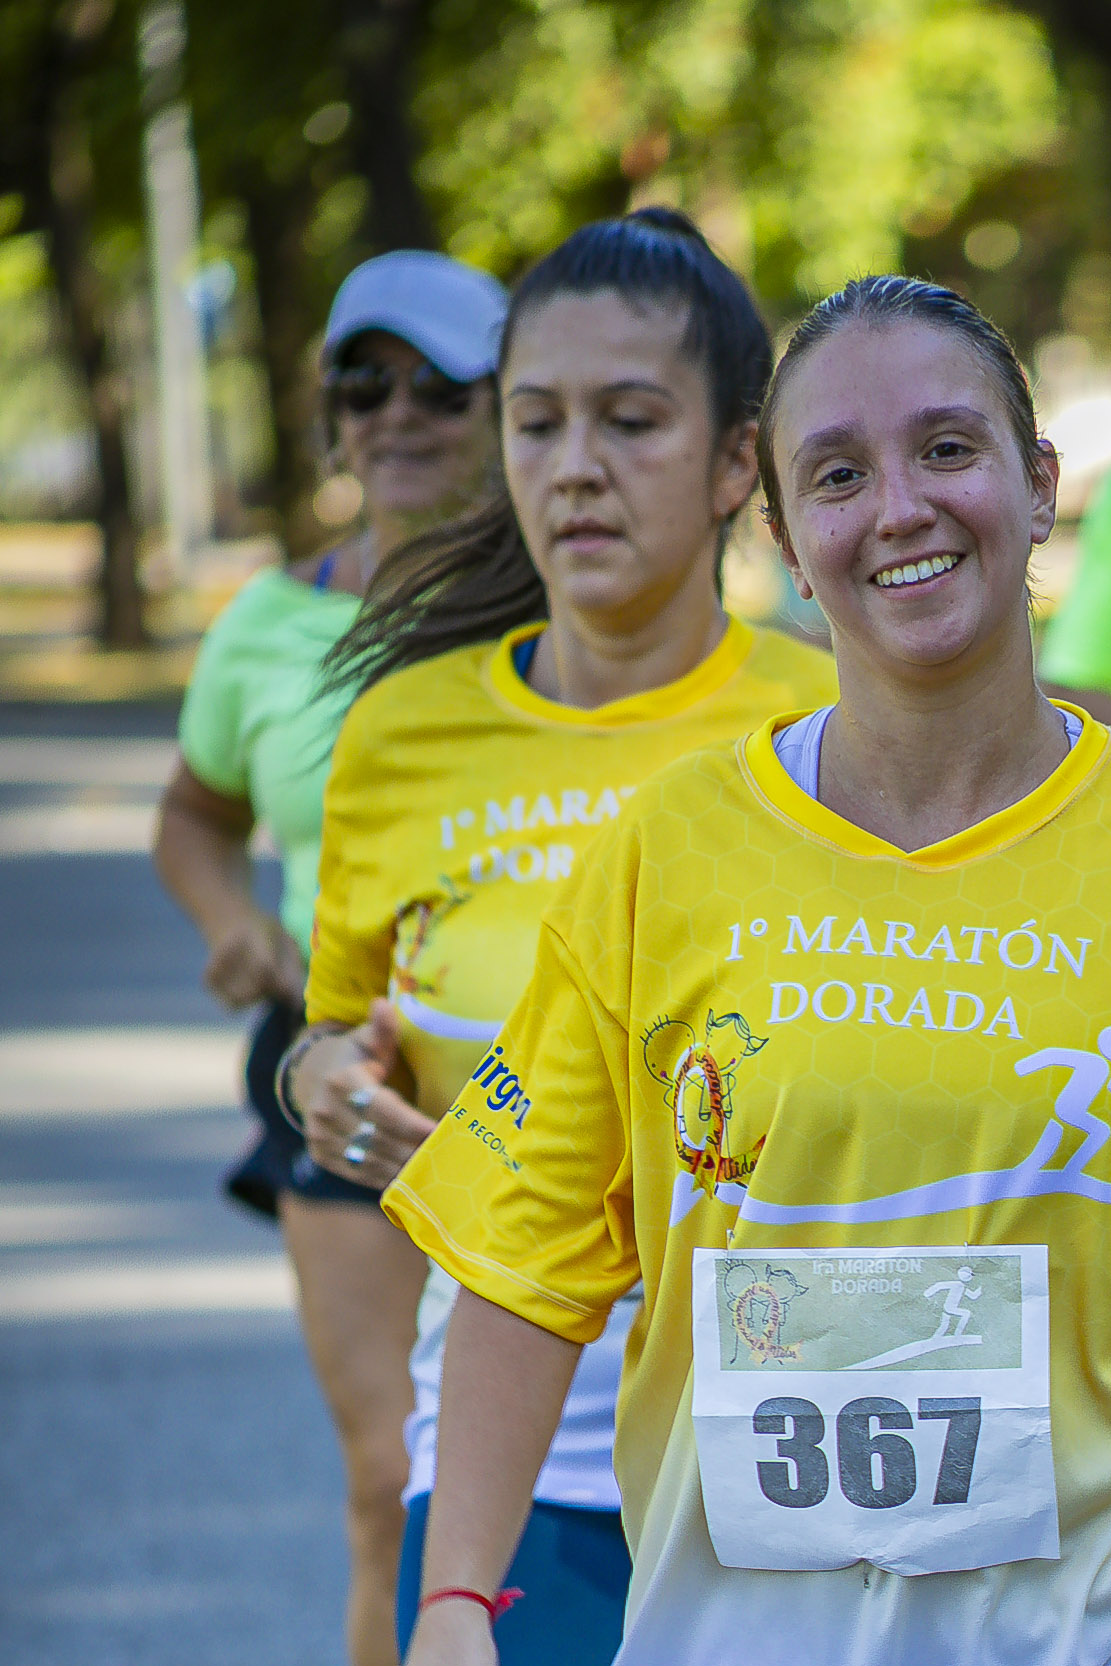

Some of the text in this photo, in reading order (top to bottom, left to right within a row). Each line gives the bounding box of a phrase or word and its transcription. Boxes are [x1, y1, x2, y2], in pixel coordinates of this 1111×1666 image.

[782, 915, 1093, 978] MARATÓN
[766, 980, 1024, 1039] DORADA
[831, 1278, 903, 1296] DORADA
[752, 1396, 982, 1510] 367
